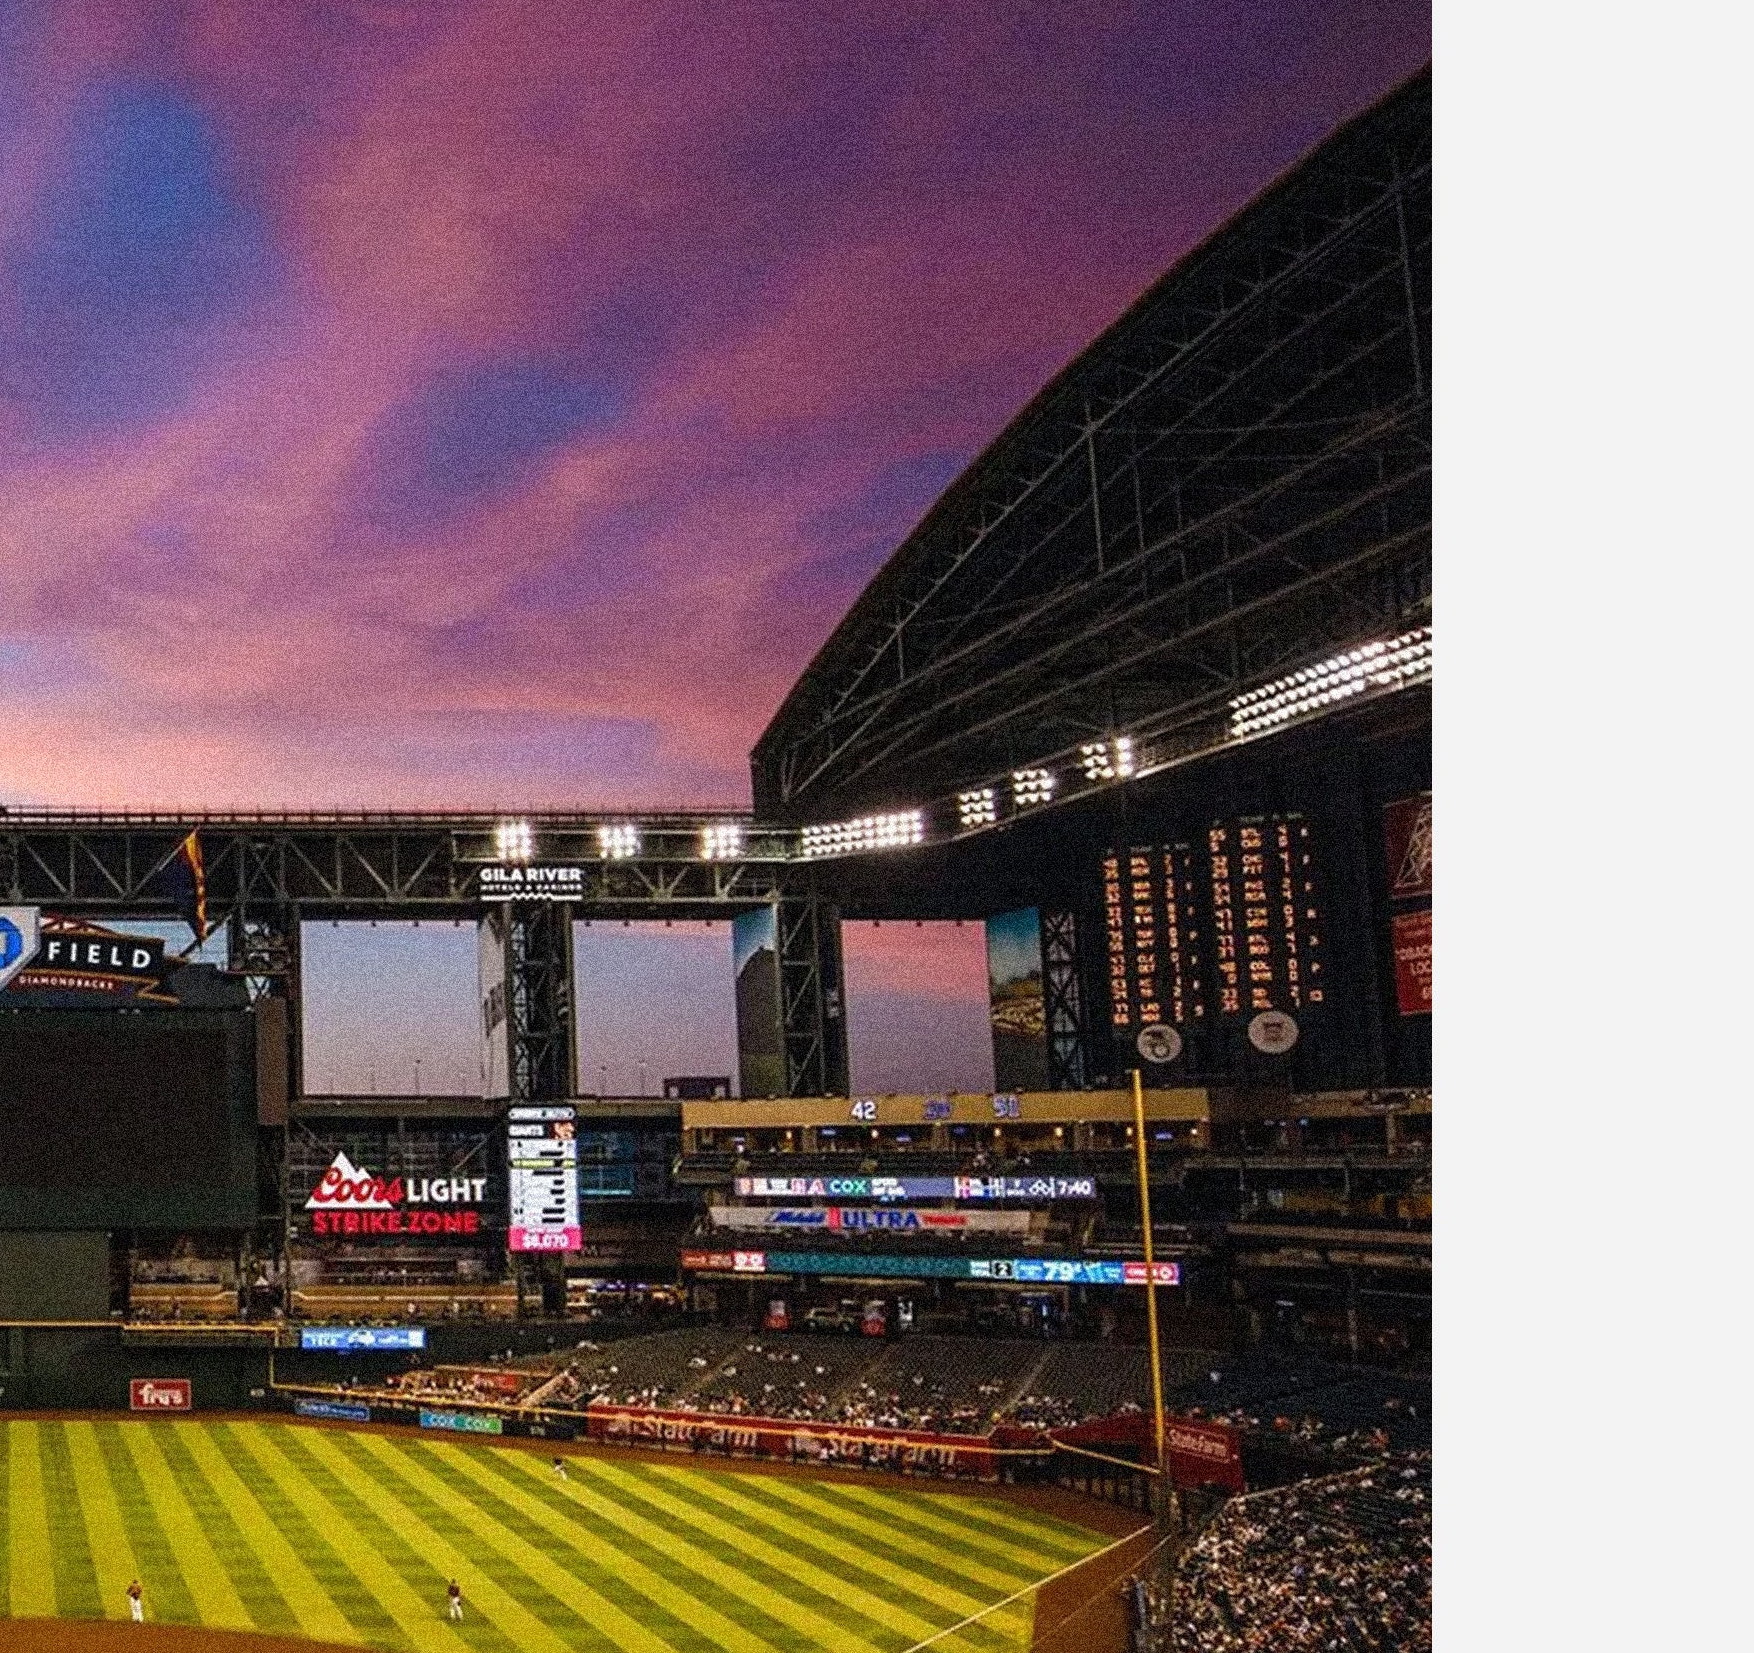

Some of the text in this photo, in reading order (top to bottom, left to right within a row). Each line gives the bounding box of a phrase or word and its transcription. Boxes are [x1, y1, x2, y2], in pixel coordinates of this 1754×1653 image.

[480, 867, 582, 882] GILA RIVER
[47, 940, 153, 969] FIELD
[18, 975, 115, 991] DIAMONDBACKS
[850, 1100, 878, 1120] 42
[314, 1166, 486, 1204] Coors LIGHT
[830, 1179, 868, 1195] COX
[312, 1211, 479, 1235] STRIKE ZONE
[843, 1210, 920, 1230] ULTRA
